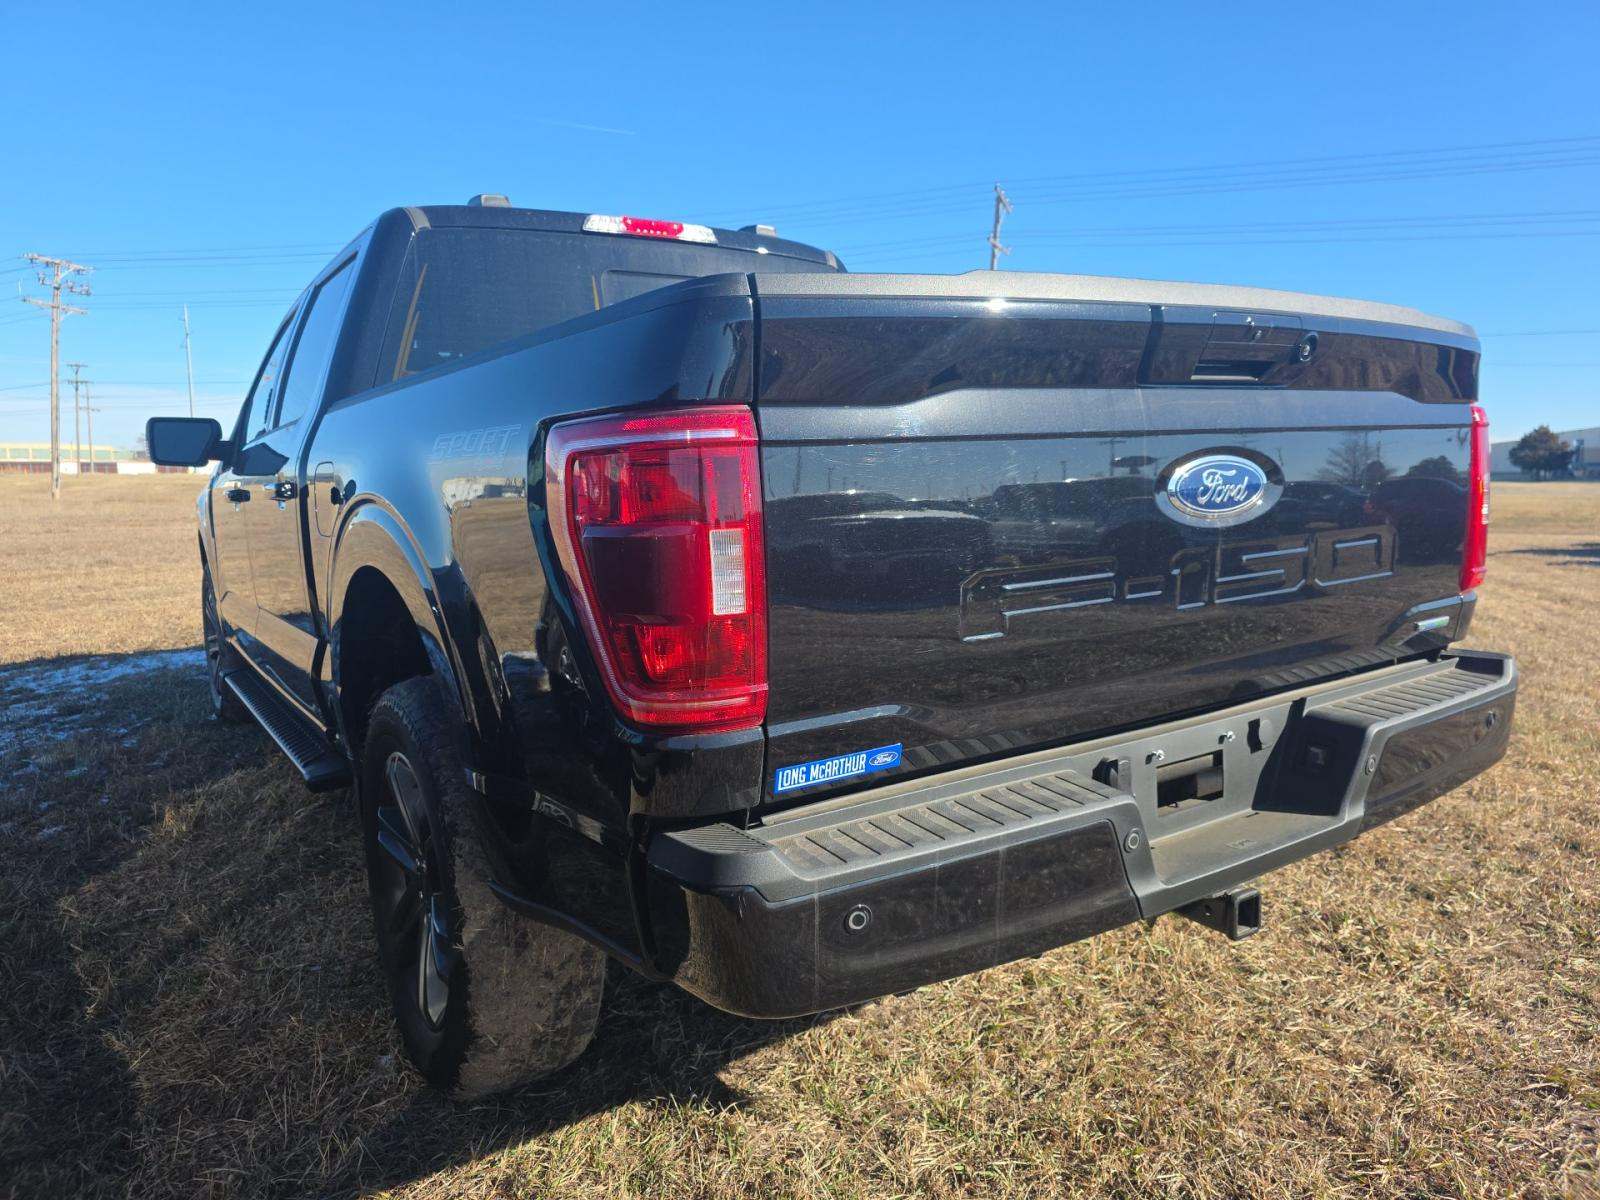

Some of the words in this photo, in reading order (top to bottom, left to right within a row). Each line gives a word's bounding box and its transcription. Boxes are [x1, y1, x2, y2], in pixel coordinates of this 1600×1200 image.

[431, 424, 521, 458] SPORT
[1197, 468, 1249, 505] Ford
[959, 525, 1397, 642] F-150
[777, 766, 807, 790] LONG
[809, 753, 867, 780] McARTHUR
